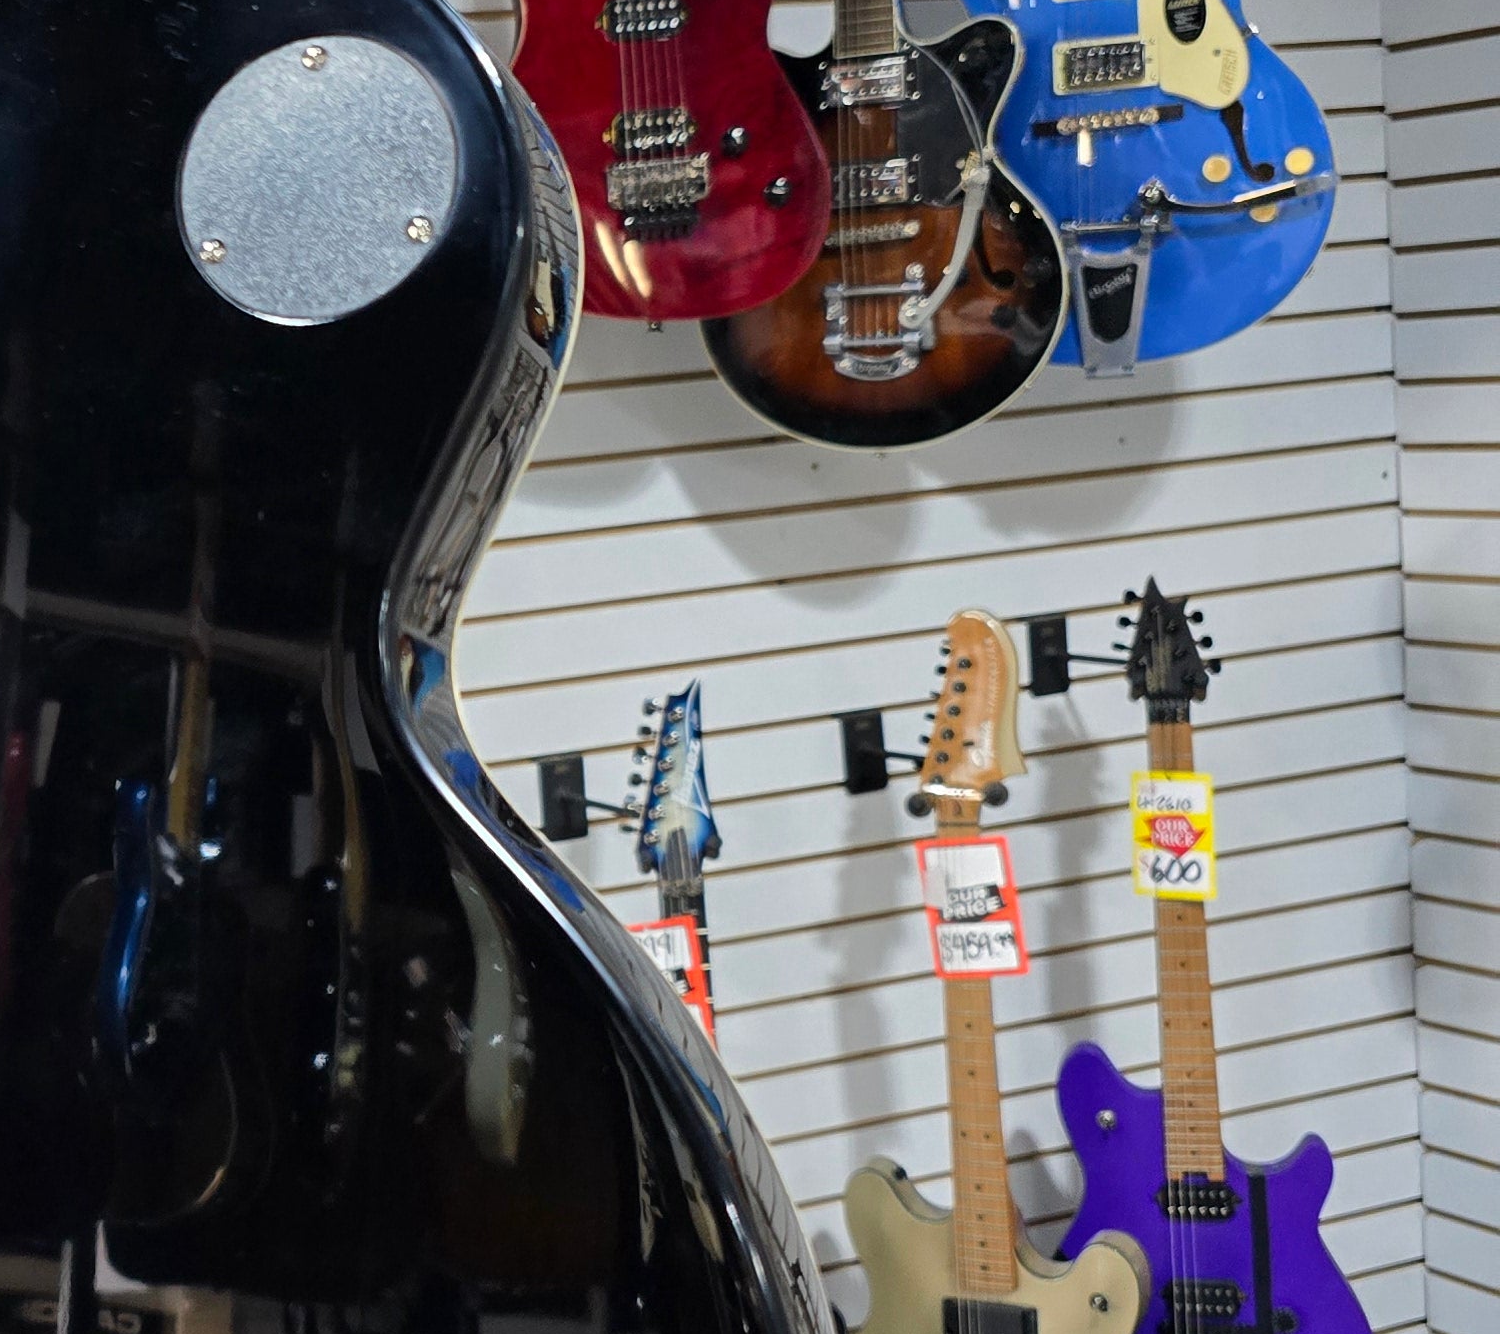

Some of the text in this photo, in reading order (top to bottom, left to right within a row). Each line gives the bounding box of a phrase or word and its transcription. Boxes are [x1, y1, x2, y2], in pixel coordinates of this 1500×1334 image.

[1154, 817, 1189, 833] OUR
[1150, 828, 1195, 848] PRICE
[942, 895, 1002, 921] PRICE
